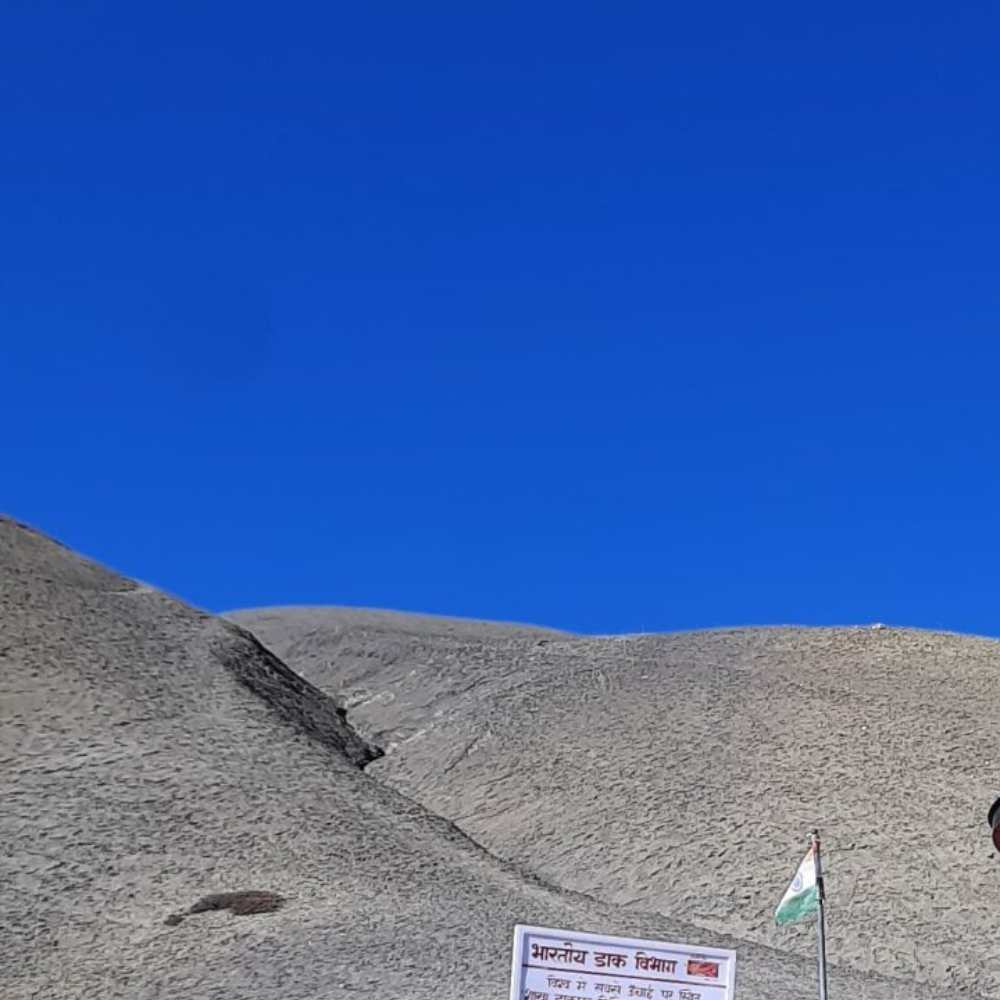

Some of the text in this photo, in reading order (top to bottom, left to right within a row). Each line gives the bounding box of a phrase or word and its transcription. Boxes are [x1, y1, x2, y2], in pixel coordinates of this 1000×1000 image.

[531, 942, 678, 974] भारतीय डाक विभाग
